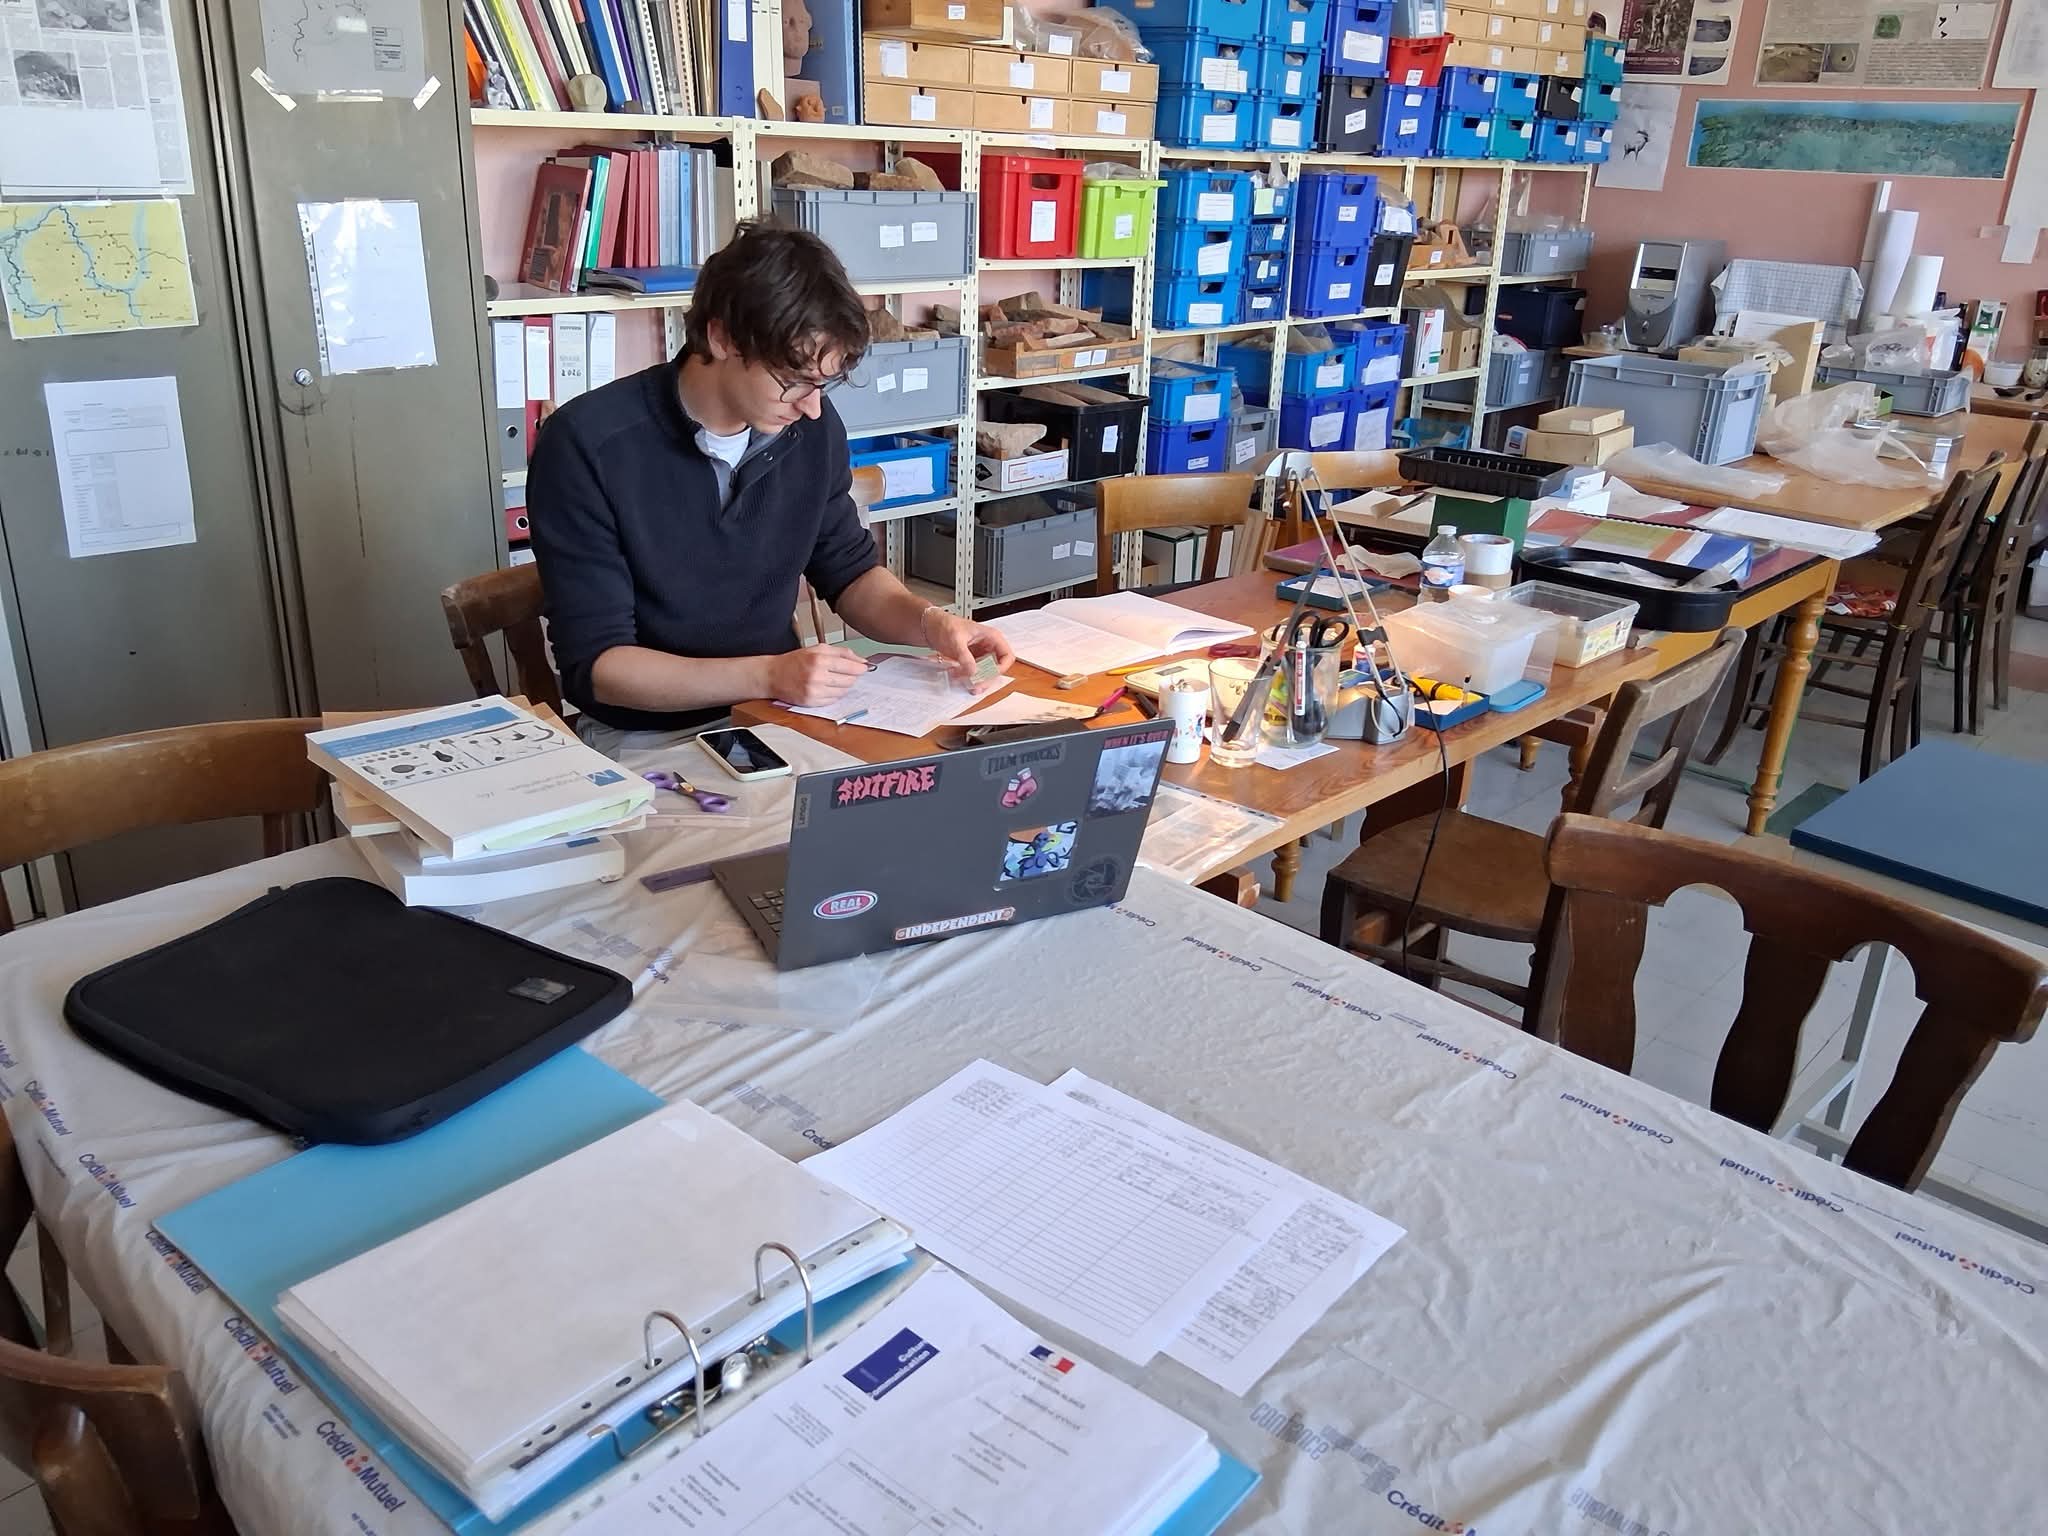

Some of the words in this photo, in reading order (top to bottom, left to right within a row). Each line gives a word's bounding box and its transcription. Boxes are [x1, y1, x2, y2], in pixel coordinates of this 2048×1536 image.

[837, 765, 937, 806] SPITFIRE
[830, 898, 863, 912] REAL
[904, 910, 1003, 939] INDEPENDENT
[1292, 981, 1333, 1001] Mutuel
[1416, 1033, 1462, 1054] Mutuel
[1560, 1093, 1611, 1118] Mutuel
[802, 1129, 838, 1150] Créd
[1627, 1120, 1674, 1144] Crédit
[1719, 1157, 1776, 1185] Mutuel
[1793, 1188, 1844, 1213] Crédit
[1895, 1231, 1956, 1262] Mutuel
[1979, 1265, 2036, 1295] Crédit
[257, 1355, 300, 1395] Mutuel
[316, 1420, 356, 1460] Crédit
[357, 1466, 406, 1513] Mutuel
[1387, 1490, 1446, 1532] Crédit
